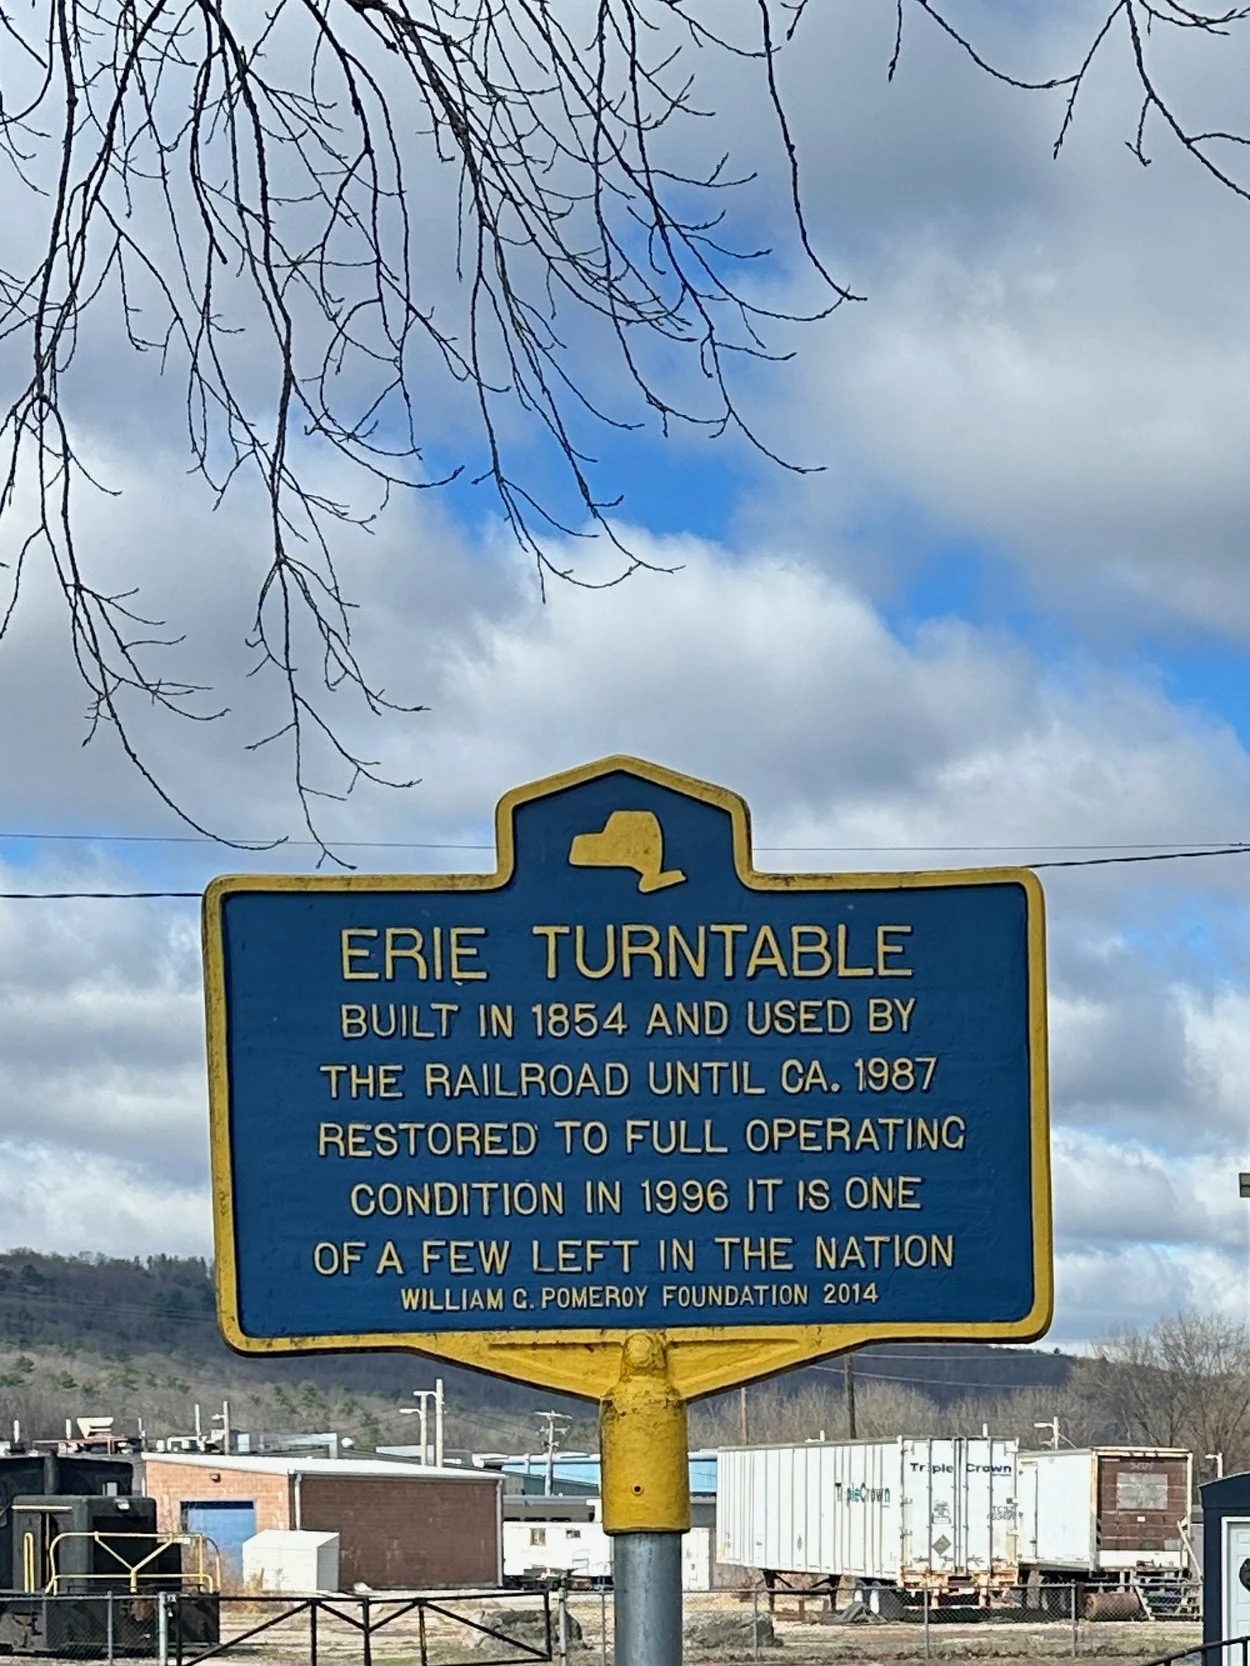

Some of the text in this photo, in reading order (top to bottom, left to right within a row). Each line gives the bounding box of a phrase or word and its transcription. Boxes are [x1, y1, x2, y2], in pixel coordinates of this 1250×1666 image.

[343, 925, 913, 979] ERIE TURNTABLE
[342, 1000, 915, 1037] BUILT IN 1854 AND USED BY
[321, 1058, 935, 1096] THE RAILROAD UNTIL CA. 1987
[320, 1116, 963, 1156] RESTORED TO FULL OPERATING
[352, 1177, 922, 1215] CONDITION IN 1996 IT IS ONE
[315, 1236, 952, 1274] OF A FEW LEFT IN THE NATION
[401, 1282, 879, 1311] WILLIAM G. POMEROY FOUNDATION 2014
[965, 1463, 1012, 1473] Crown
